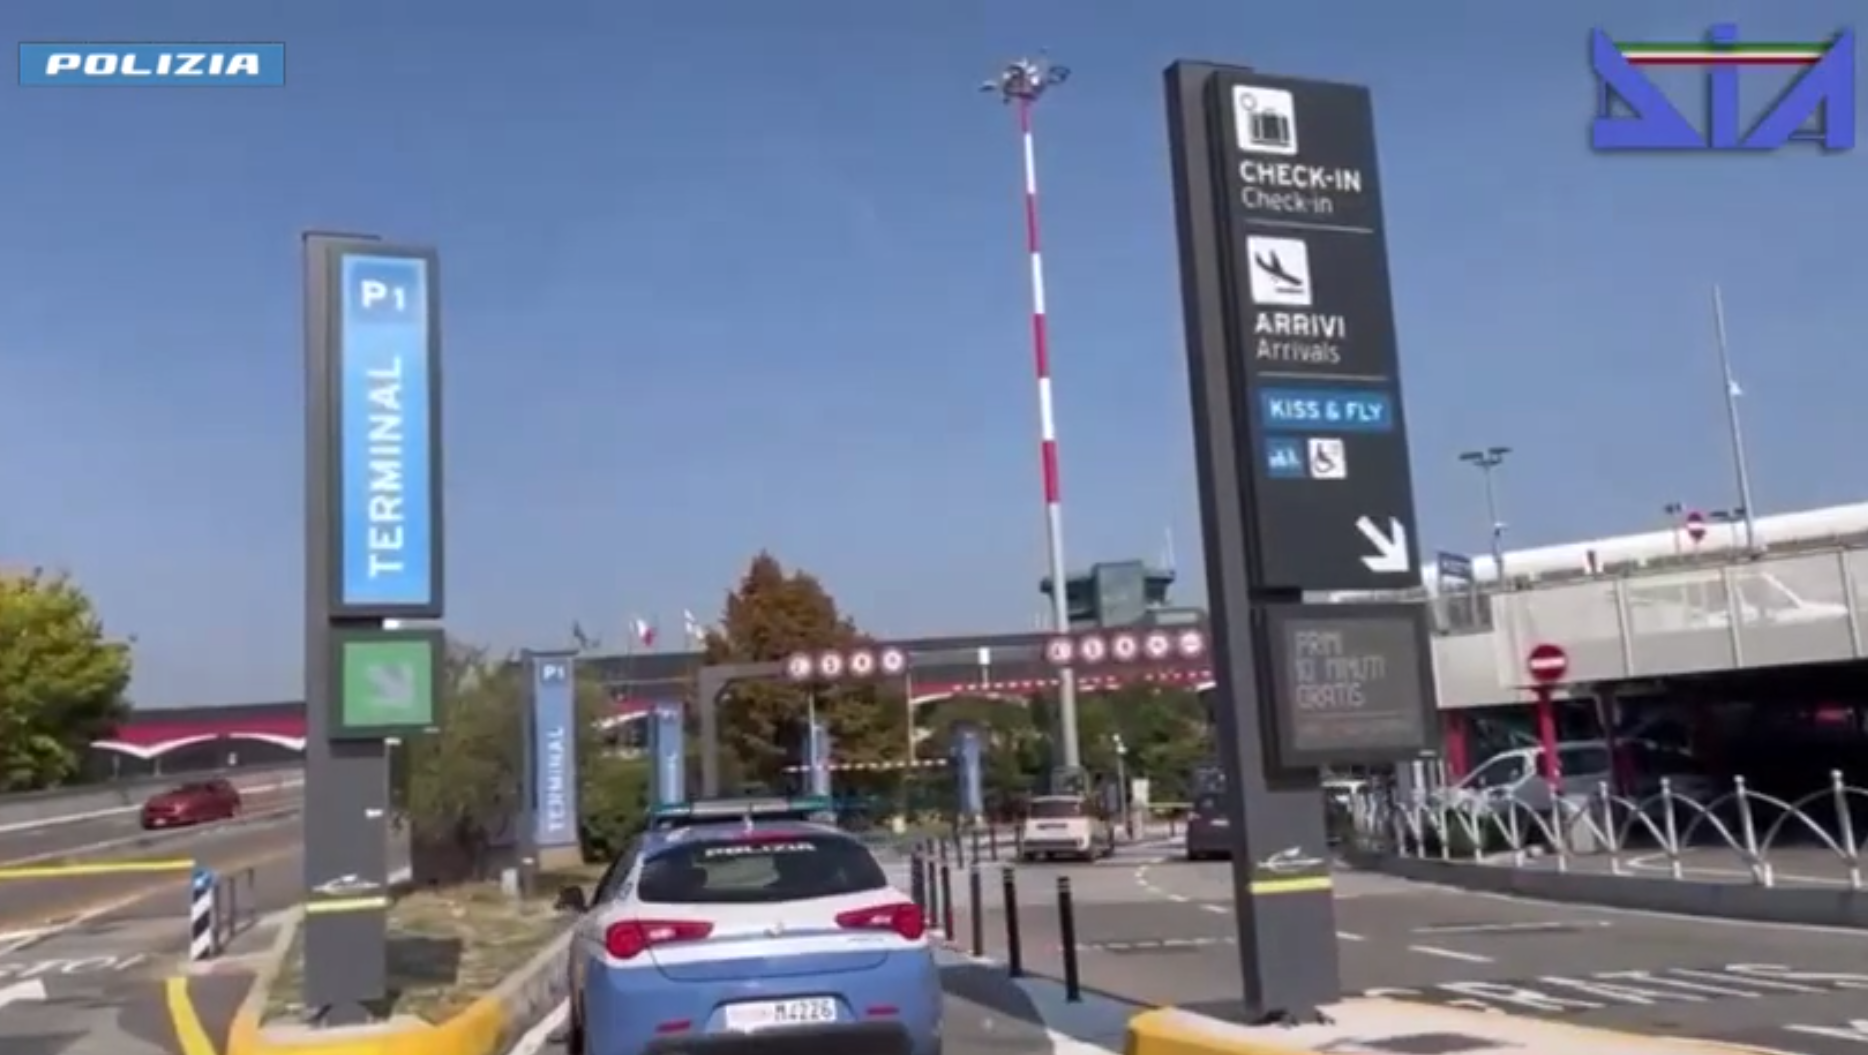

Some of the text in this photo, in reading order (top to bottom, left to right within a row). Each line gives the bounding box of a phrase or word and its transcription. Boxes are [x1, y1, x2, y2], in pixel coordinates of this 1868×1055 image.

[1240, 160, 1362, 192] CHECK-IN
[1241, 186, 1334, 214] Check-in
[1254, 311, 1346, 338] ARRIVI
[1256, 338, 1341, 364] Arrivals
[1269, 398, 1383, 422] KISS & FLY
[366, 356, 406, 579] TERMINAL
[543, 664, 566, 682] P1
